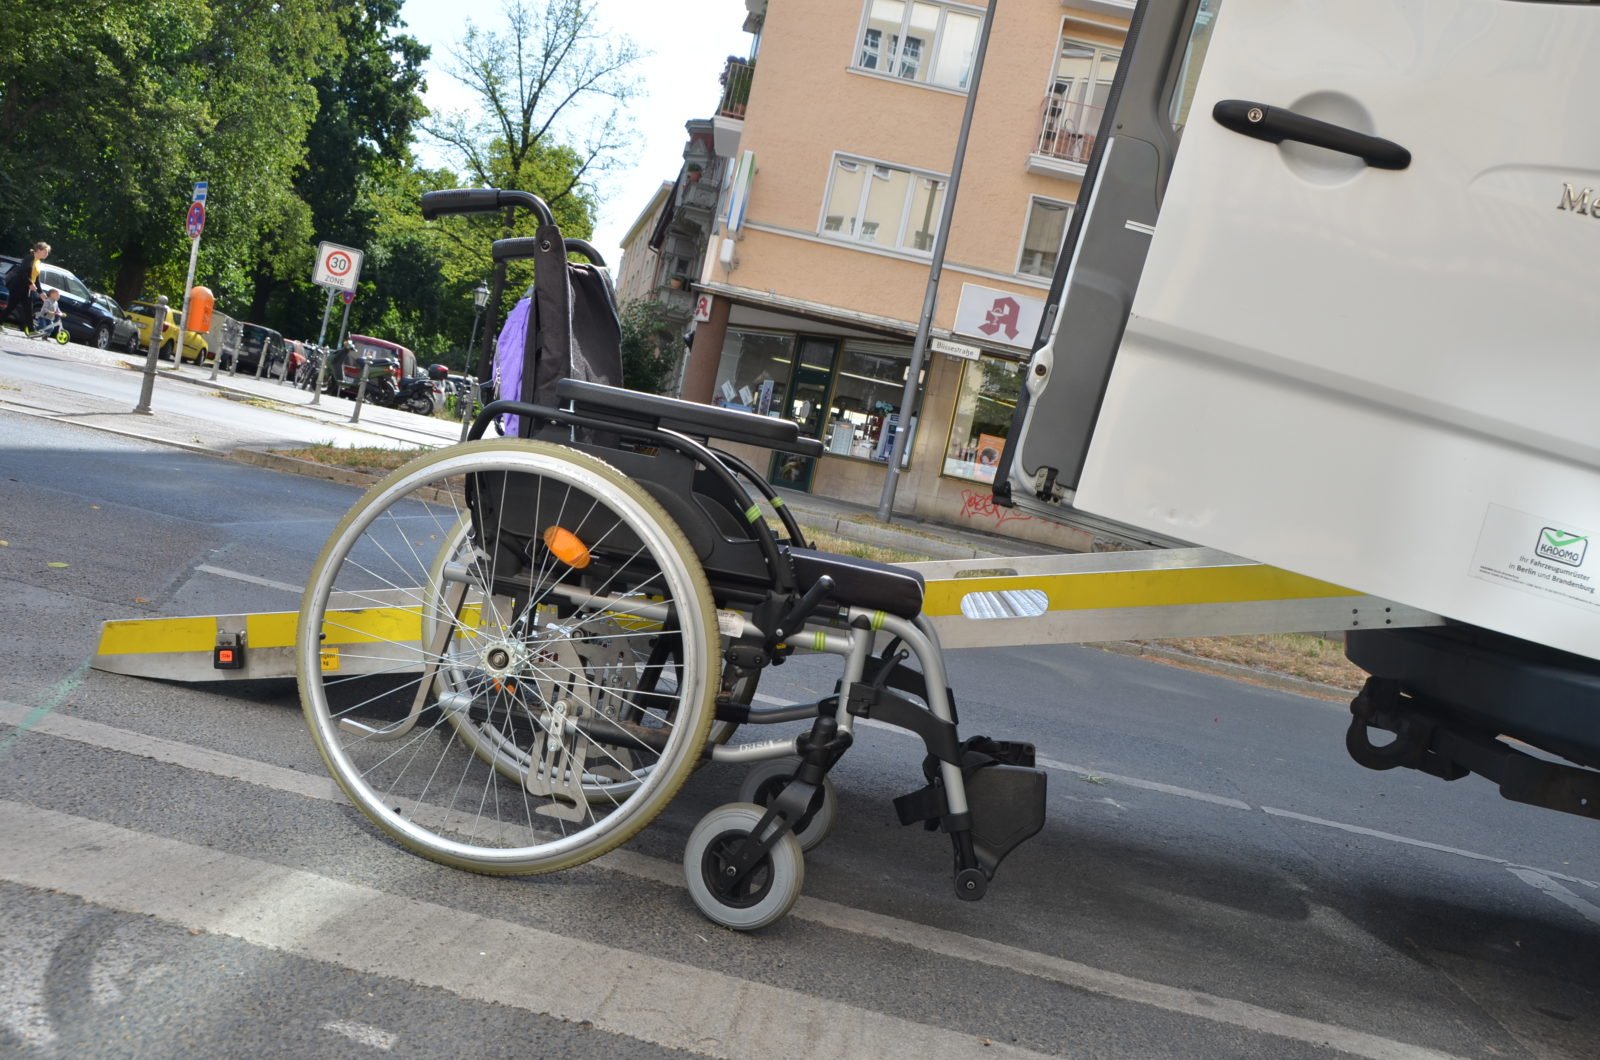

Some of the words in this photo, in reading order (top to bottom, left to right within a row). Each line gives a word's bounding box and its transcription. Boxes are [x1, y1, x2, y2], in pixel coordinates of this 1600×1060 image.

[331, 257, 347, 271] 30
[325, 275, 345, 286] ZONE
[1540, 543, 1579, 562] KADOMO
[1519, 555, 1529, 564] Ihr
[1529, 558, 1591, 581] Fahrzeugumrüster
[1508, 562, 1516, 570] in
[1516, 564, 1537, 576] Berlin
[1537, 571, 1551, 580] und
[1551, 575, 1596, 594] Brandenburg
